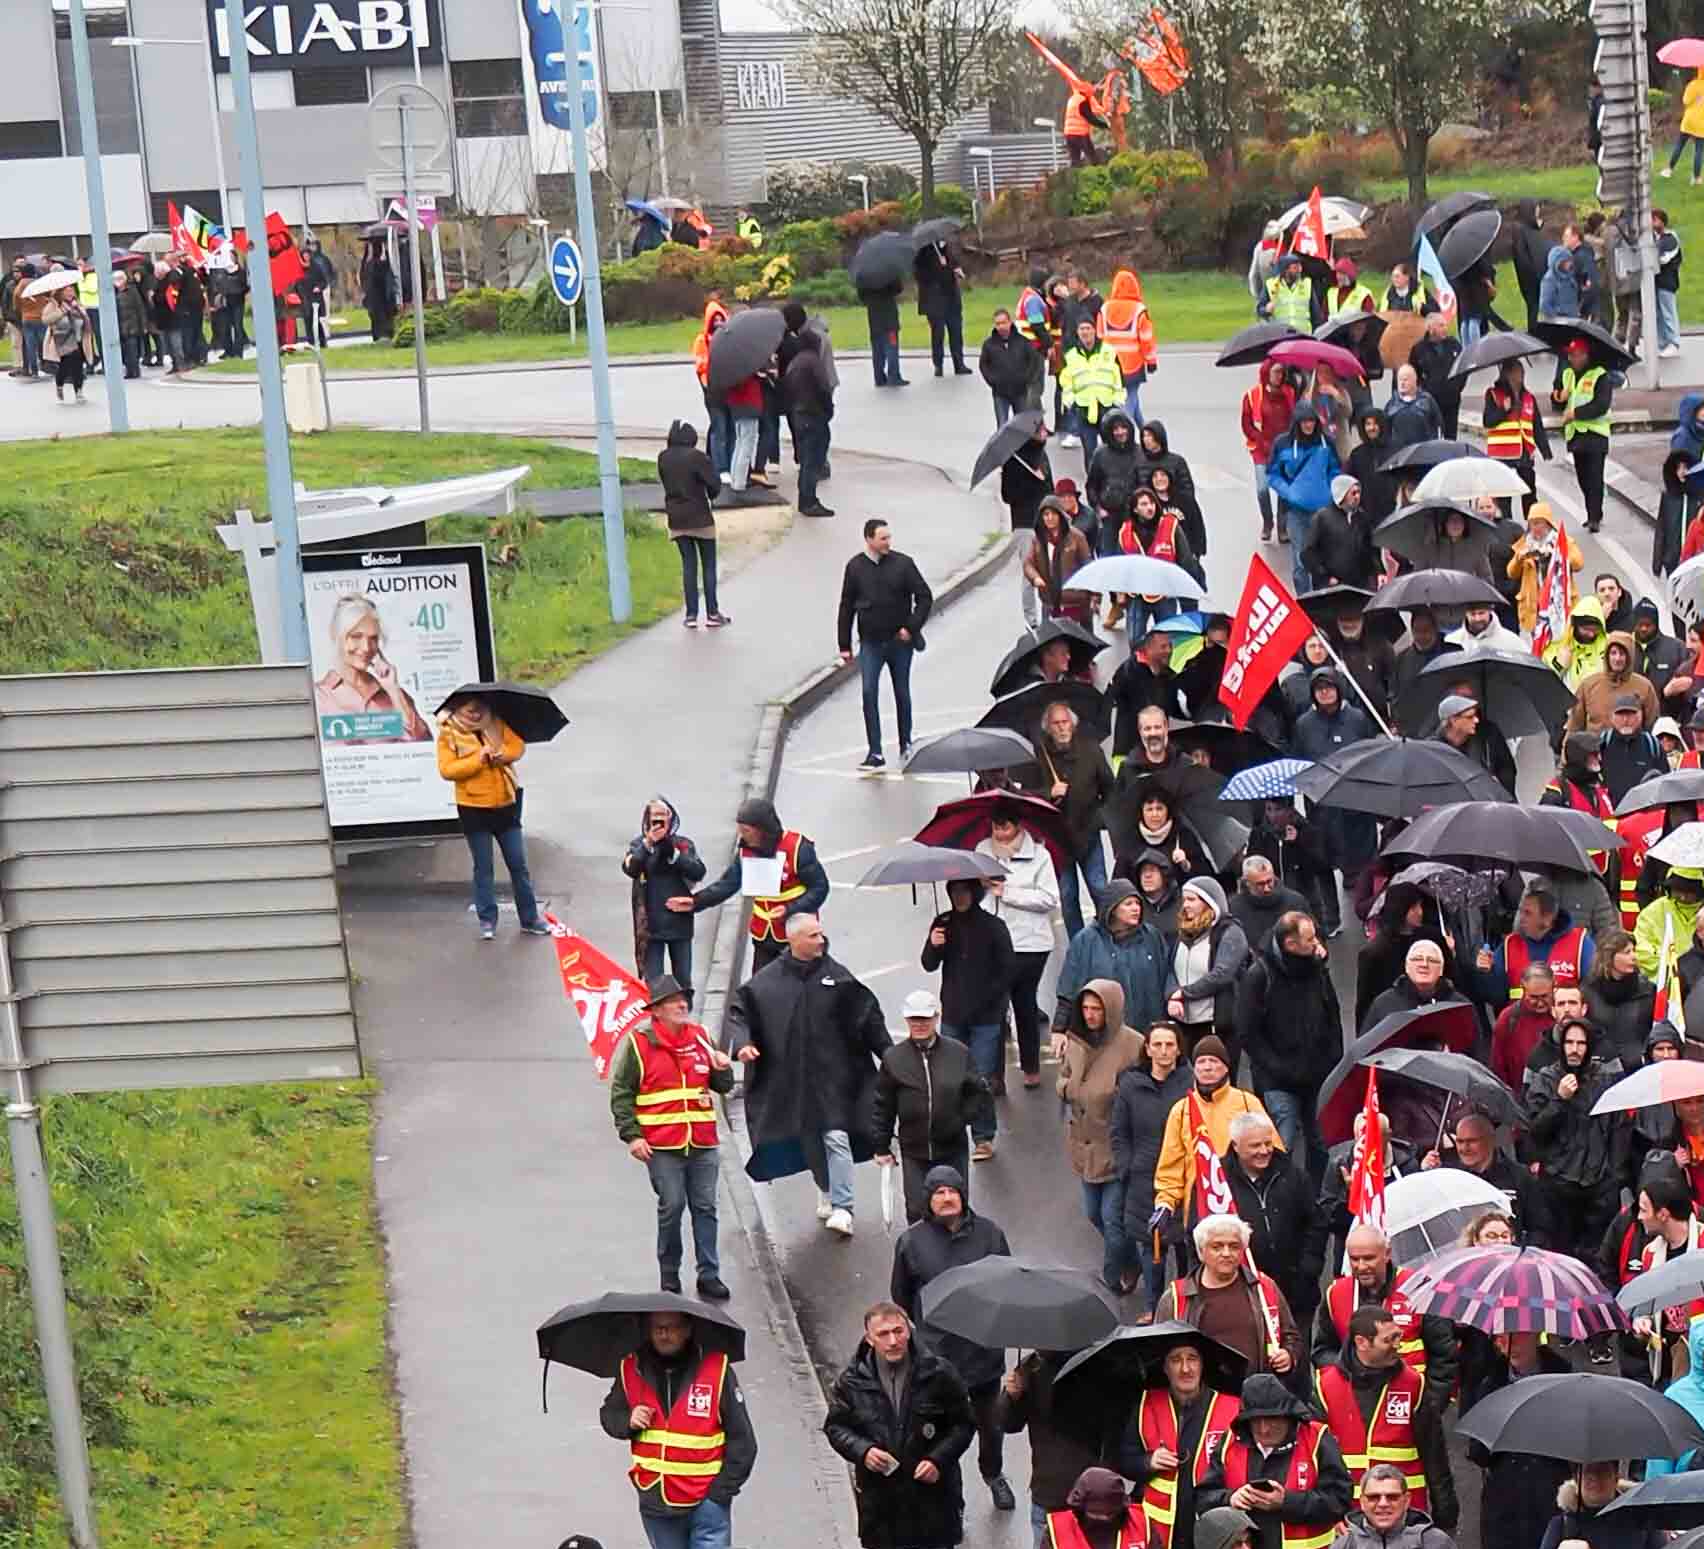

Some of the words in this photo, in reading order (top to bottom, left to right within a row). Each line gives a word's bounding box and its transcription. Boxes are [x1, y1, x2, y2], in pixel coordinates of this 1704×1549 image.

[214, 0, 430, 57] KIABI
[738, 63, 787, 109] KIABI
[366, 573, 457, 594] AUDITION
